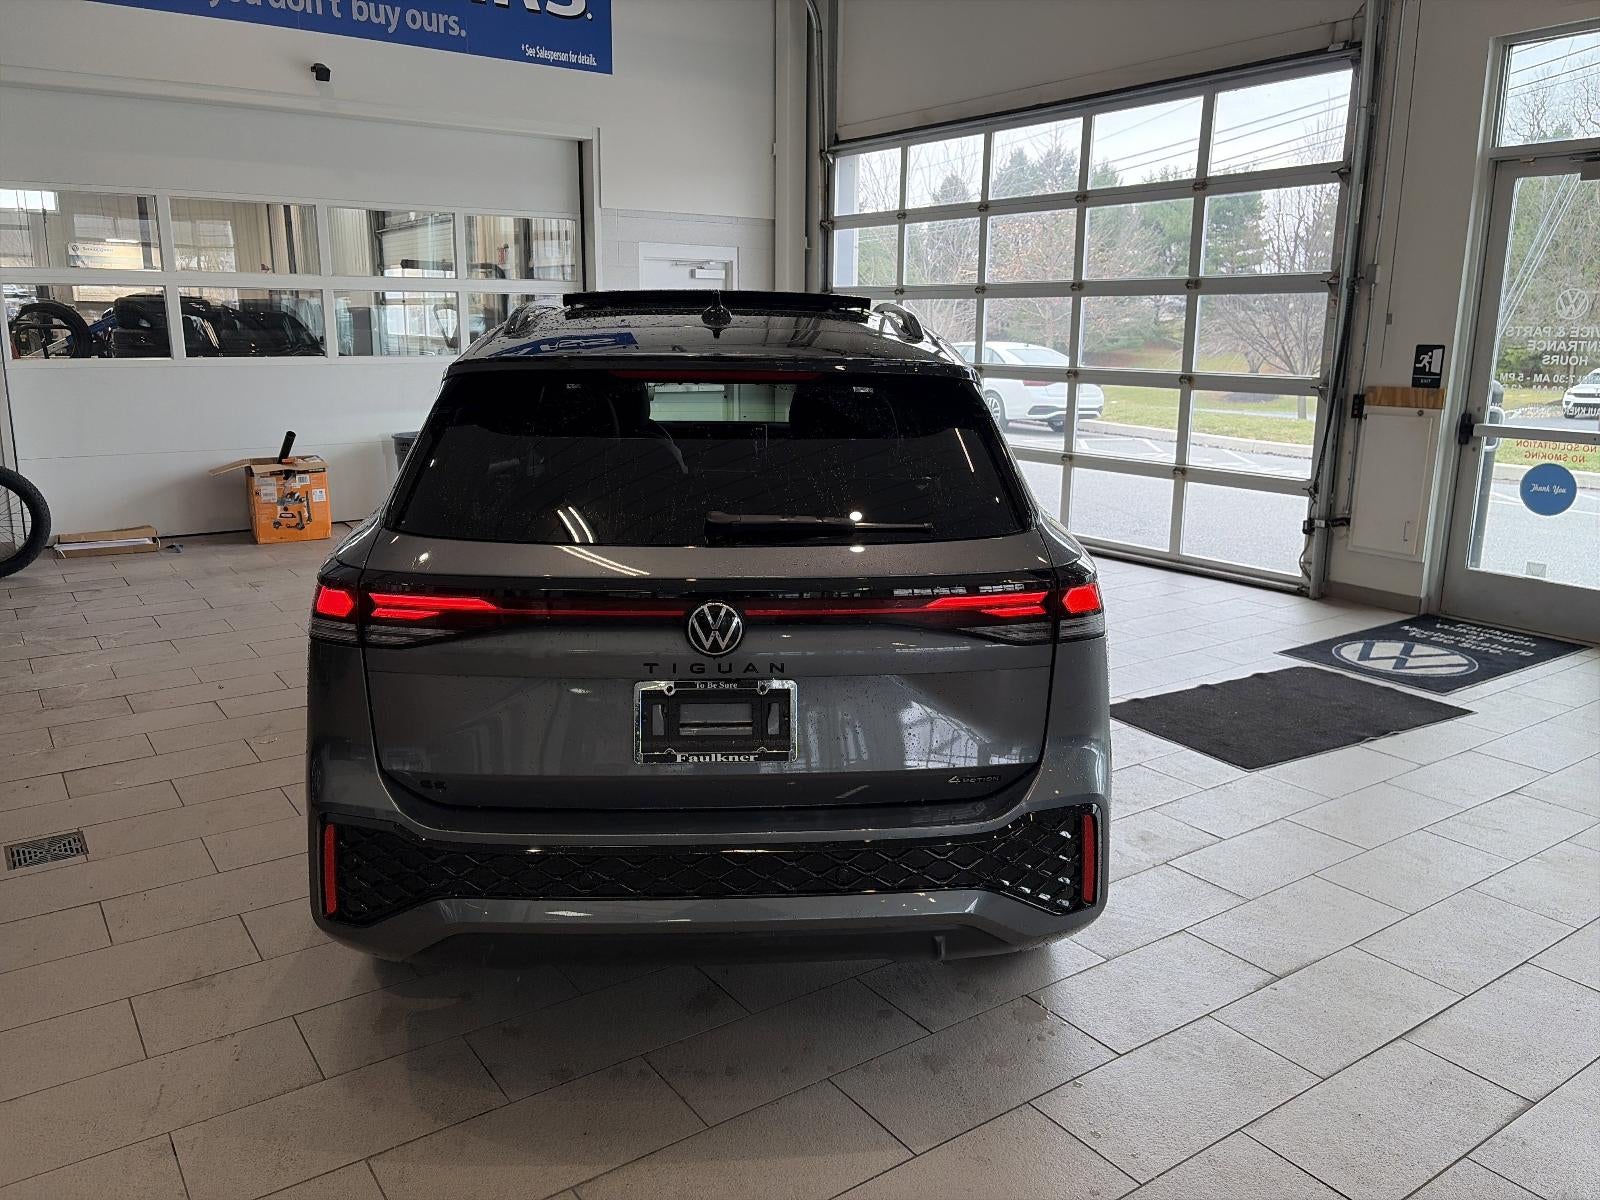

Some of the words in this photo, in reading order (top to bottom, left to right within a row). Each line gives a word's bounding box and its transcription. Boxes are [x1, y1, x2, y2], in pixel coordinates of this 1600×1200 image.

[352, 0, 400, 34] buy
[405, 8, 467, 38] ours.
[536, 46, 569, 62] Salesperson
[569, 50, 577, 64] for
[577, 51, 597, 66] details.
[1530, 483, 1550, 493] Thank
[1553, 484, 1567, 495] You
[643, 662, 785, 674] TIGUAN
[694, 681, 705, 689] To
[707, 681, 717, 689] Be
[718, 681, 738, 689] Sure
[675, 753, 759, 763] Faulkner
